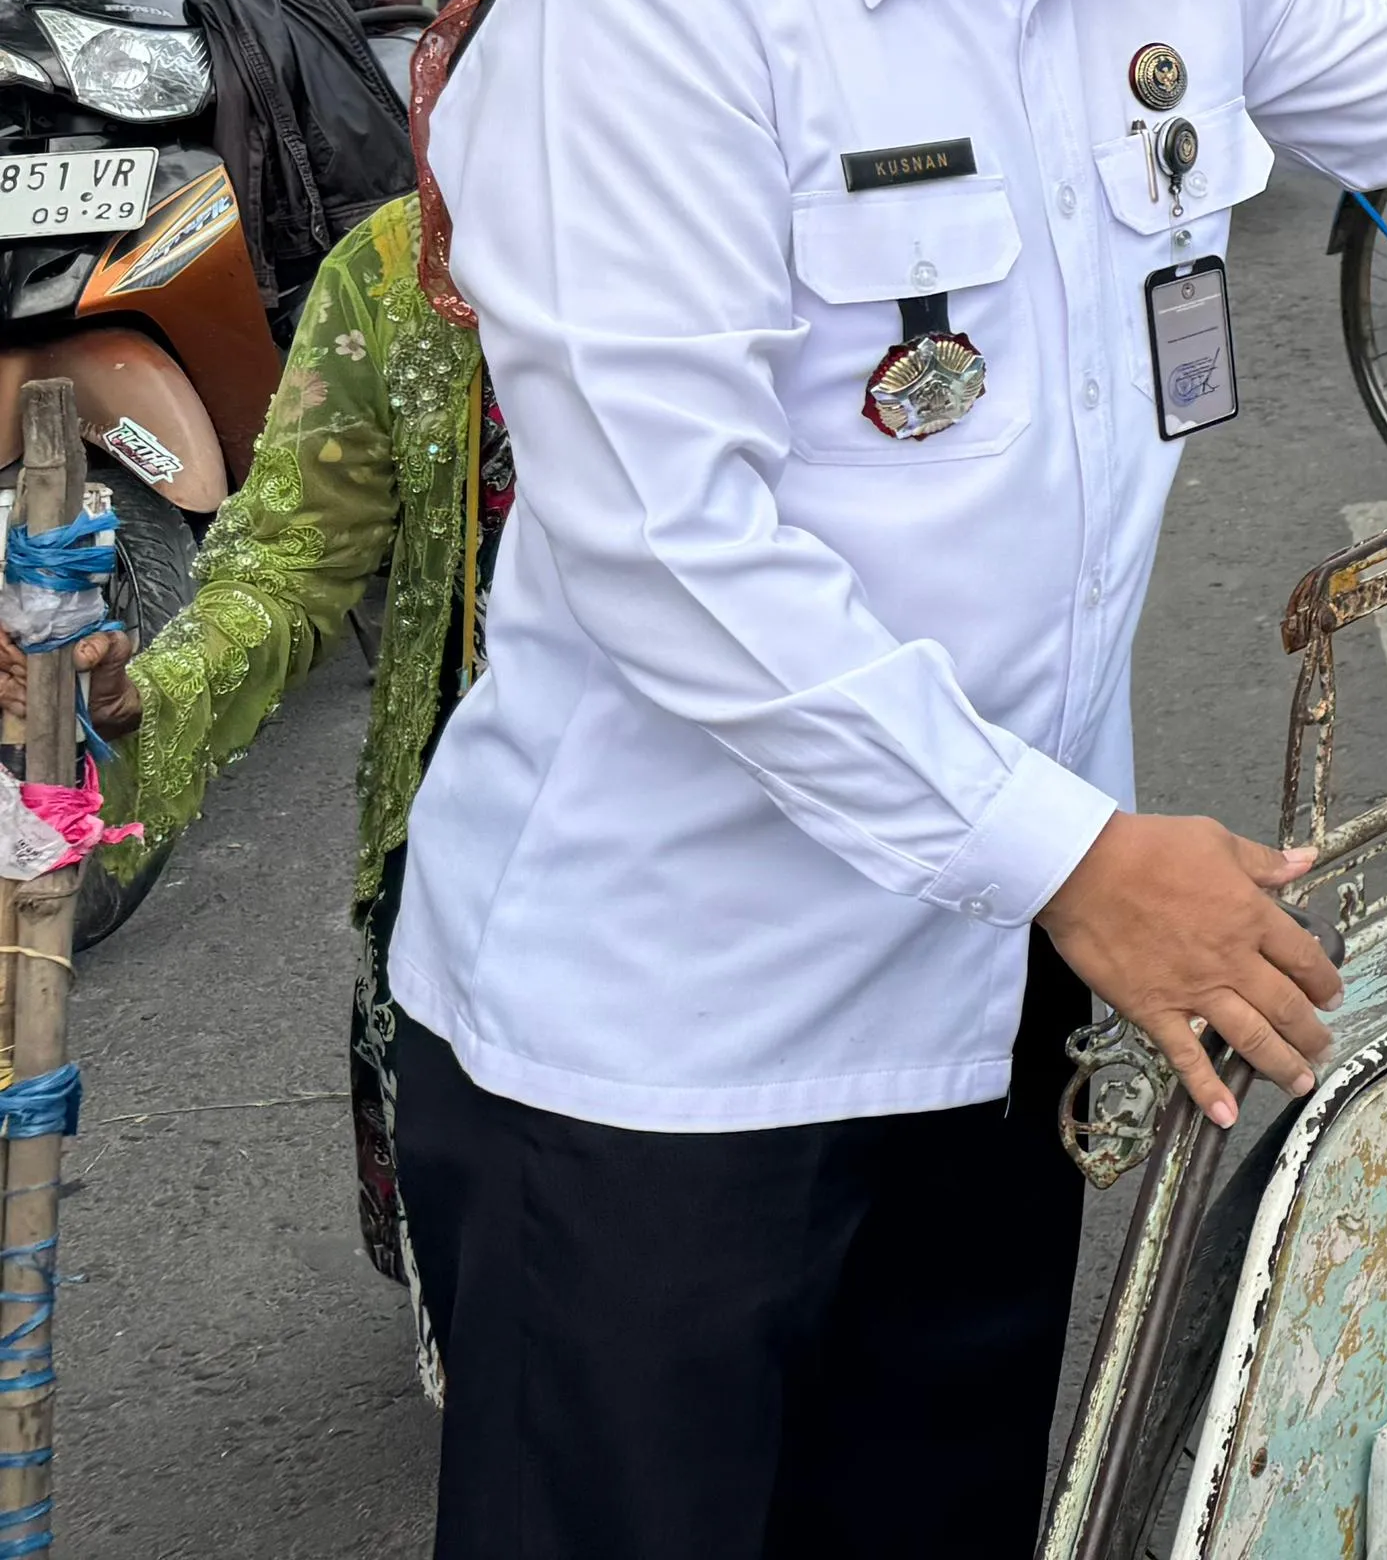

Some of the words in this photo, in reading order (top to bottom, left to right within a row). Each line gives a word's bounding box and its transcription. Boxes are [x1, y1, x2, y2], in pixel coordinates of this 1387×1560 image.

[104, 3, 175, 18] HONDA
[0, 161, 70, 192] 851
[93, 158, 136, 187] VR
[874, 152, 949, 177] KUSNAN
